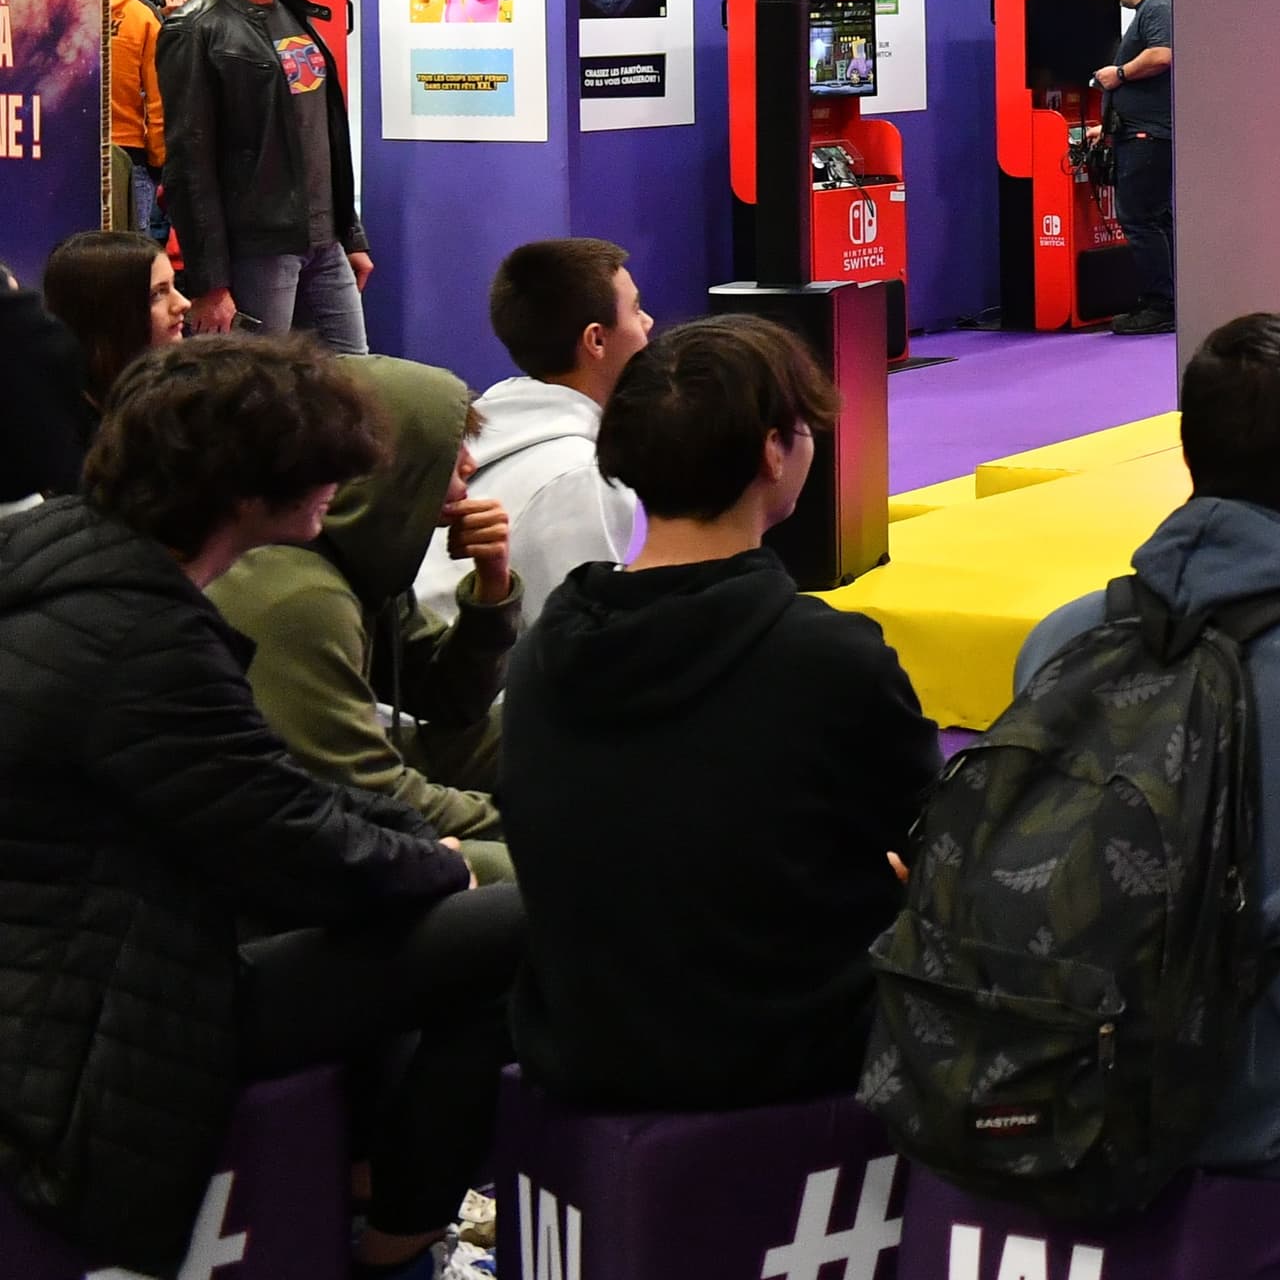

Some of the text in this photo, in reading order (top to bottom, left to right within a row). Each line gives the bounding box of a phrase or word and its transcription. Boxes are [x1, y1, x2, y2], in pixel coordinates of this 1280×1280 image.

[0, 94, 42, 159] E !
[843, 246, 884, 258] NINTENDO
[843, 254, 885, 271] SWITCH
[976, 1114, 1037, 1128] EASTPAK
